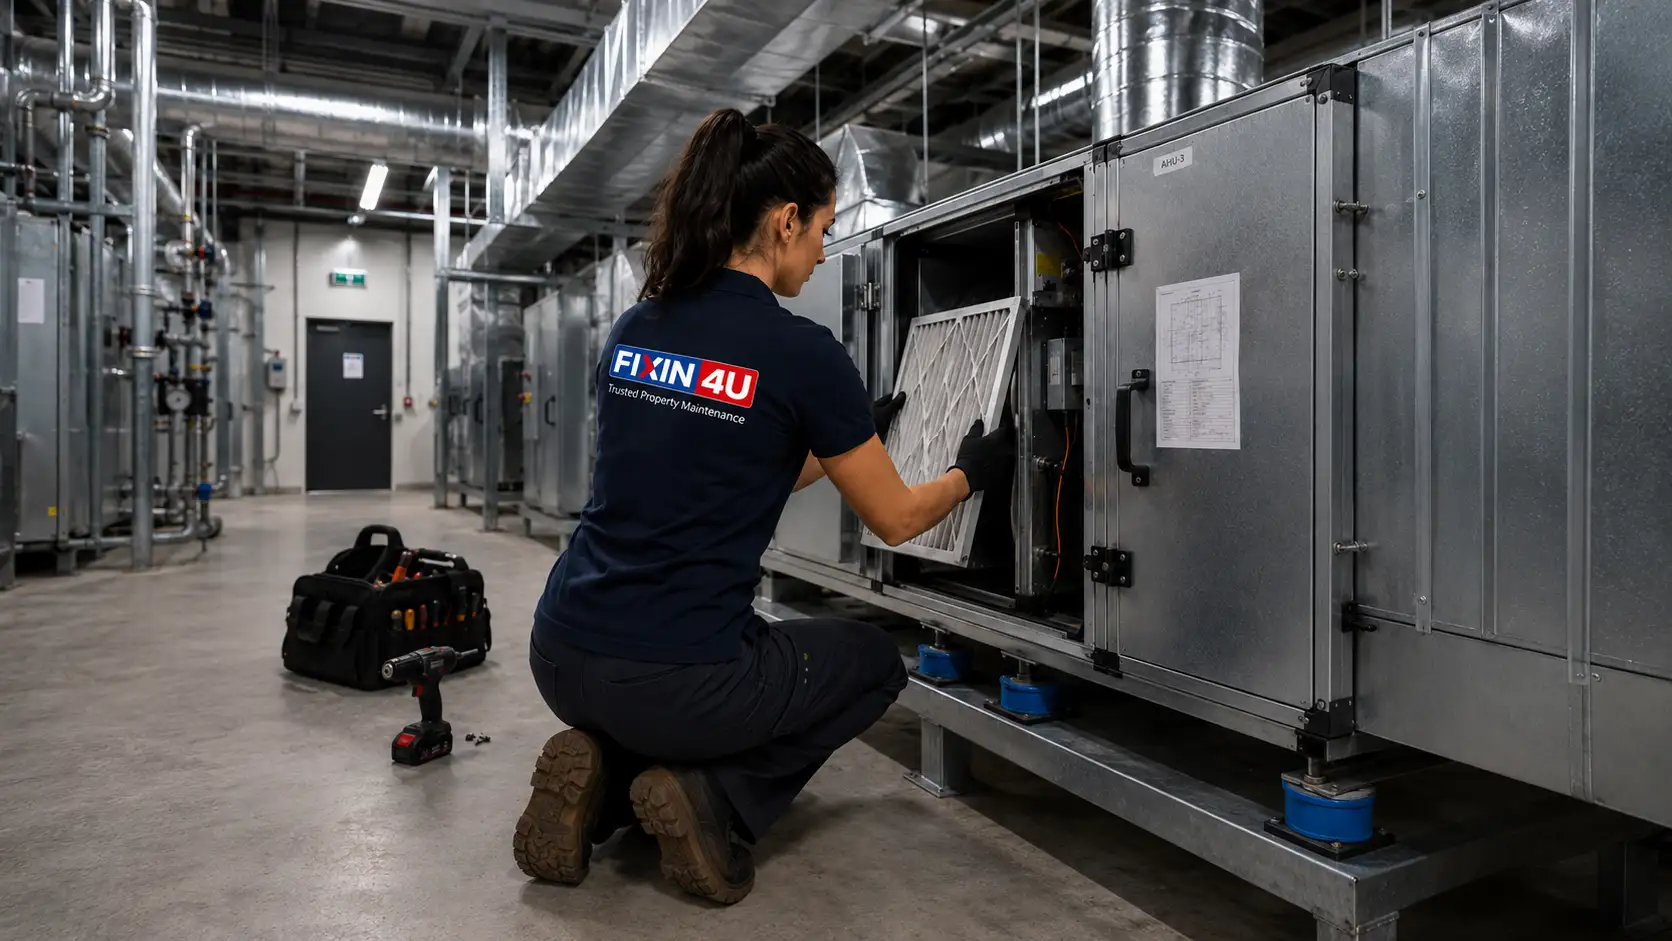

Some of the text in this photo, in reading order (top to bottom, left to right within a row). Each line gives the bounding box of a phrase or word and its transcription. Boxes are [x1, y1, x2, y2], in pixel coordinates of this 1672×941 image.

[1161, 154, 1185, 168] AHU-3
[613, 350, 752, 400] FIXIN 4U
[608, 383, 746, 425] Trusted Property Maintenance
